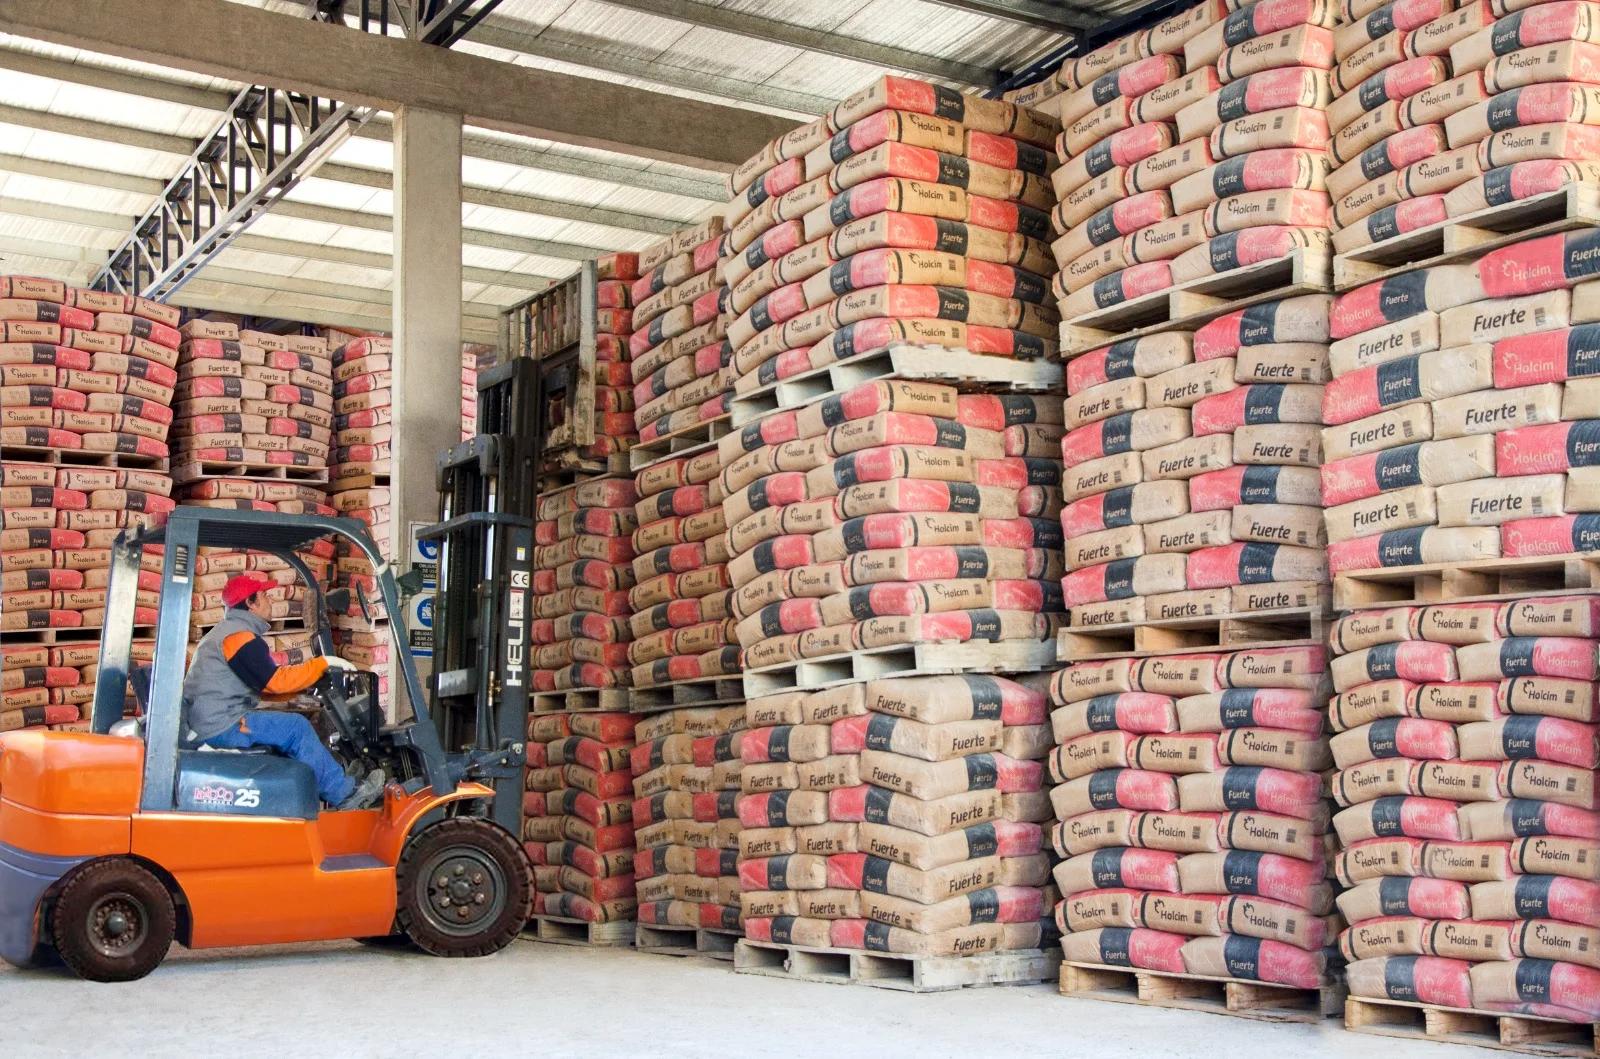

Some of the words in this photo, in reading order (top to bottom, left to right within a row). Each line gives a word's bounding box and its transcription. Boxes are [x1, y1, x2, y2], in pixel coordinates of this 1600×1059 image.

[1165, 18, 1190, 37] Holcim
[1429, 21, 1454, 37] Holcim
[1495, 30, 1516, 44] Fuerte
[1248, 40, 1274, 56] Holcim
[1352, 51, 1374, 68] Holcim
[1515, 56, 1541, 69] Holcim
[1158, 88, 1180, 104] Holcim
[1364, 87, 1381, 101] Fuerte
[1426, 91, 1451, 106] Holcim
[940, 97, 960, 110] Fuerte
[1221, 95, 1242, 111] Fuerte
[1493, 108, 1511, 120] Fuerte
[917, 122, 942, 133] Holcim
[1240, 121, 1266, 136] Holcim
[1507, 136, 1534, 149] Holcim
[1089, 153, 1108, 167] Fuerte
[1152, 158, 1177, 173] Holcim
[903, 166, 931, 179] Holcim
[1424, 165, 1450, 179] Holcim
[1218, 173, 1237, 186] Fuerte
[919, 189, 943, 200] Holcim
[1233, 202, 1260, 216] Holcim
[942, 233, 963, 243] Fuerte
[1151, 230, 1176, 245] Holcim
[1513, 264, 1551, 281] Holcim
[1100, 289, 1118, 301] Fuerte
[1385, 294, 1409, 305] Fuerte
[944, 301, 965, 310] Fuerte
[1474, 308, 1526, 332] Fuerte
[205, 328, 226, 336] Fuerte
[922, 329, 945, 337] Holcim
[1245, 326, 1267, 338] Fuerte
[258, 339, 276, 348] Fuerte
[1358, 333, 1403, 359] Fuerte
[1109, 359, 1128, 369] Fuerte
[1254, 363, 1294, 377] Fuerte
[1514, 359, 1554, 375] Holcim
[1384, 377, 1411, 391] Fuerte
[682, 390, 701, 402] Fuerte
[911, 393, 936, 402] Holcim
[1164, 382, 1198, 401] Fuerte
[207, 404, 229, 412] Fuerte
[1010, 407, 1031, 415] Fuerte
[1079, 399, 1110, 418] Fuerte
[1250, 406, 1273, 416] Fuerte
[1465, 403, 1517, 425] Fuerte
[942, 431, 962, 441] Fuerte
[1350, 422, 1395, 447] Fuerte
[1253, 443, 1293, 457] Fuerte
[924, 458, 950, 466] Holcim
[1513, 452, 1555, 464] Holcim
[1159, 456, 1194, 474] Fuerte
[1382, 463, 1411, 476] Fuerte
[1077, 472, 1108, 490] Fuerte
[856, 491, 875, 501] Holcim
[954, 496, 976, 505] Fuerte
[1470, 494, 1522, 514] Fuerte
[1353, 503, 1398, 528] Fuerte
[934, 524, 959, 532] Holcim
[1250, 522, 1291, 539] Fuerte
[1160, 531, 1195, 548] Fuerte
[1385, 545, 1412, 557] Fuerte
[1518, 540, 1559, 552] Holcim
[1078, 545, 1110, 561] Fuerte
[963, 561, 983, 569] Fuerte
[1244, 566, 1267, 575] Fuerte
[802, 576, 820, 585] Holcim
[944, 588, 969, 597] Holcim
[1248, 594, 1289, 609] Fuerte
[1161, 603, 1197, 618] Fuerte
[1081, 610, 1114, 625] Fuerte
[1527, 613, 1556, 623] Holcim
[1355, 624, 1380, 636] Holcim
[1437, 619, 1464, 629] Holcim
[506, 620, 523, 686] HELI
[1506, 657, 1527, 667] Fuerte
[1158, 669, 1183, 680] Holcim
[1247, 664, 1276, 675] Holcim
[1076, 676, 1100, 687] Holcim
[1529, 691, 1557, 701] Holcim
[877, 696, 906, 712] Fuerte
[1436, 698, 1462, 707] Holcim
[754, 711, 776, 722] Fuerte
[813, 705, 838, 719] Fuerte
[1225, 709, 1247, 719] Fuerte
[684, 721, 706, 732] Fuerte
[952, 735, 985, 750] Fuerte
[1248, 741, 1277, 753] Holcim
[1373, 740, 1393, 750] Fuerte
[1156, 749, 1182, 759] Holcim
[680, 776, 698, 787] Fuerte
[809, 772, 834, 785] Fuerte
[872, 767, 902, 786] Fuerte
[1438, 776, 1466, 786] Holcim
[1530, 776, 1559, 788] Holcim
[234, 789, 260, 807] 25
[1093, 792, 1113, 801] Fuerte
[1228, 790, 1250, 799] Fuerte
[950, 806, 983, 825] Fuerte
[1518, 817, 1539, 827] Fuerte
[684, 831, 702, 842] Fuerte
[1079, 826, 1101, 838] Holcim
[1158, 827, 1185, 838] Holcim
[1250, 827, 1279, 839] Holcim
[807, 839, 832, 850] Fuerte
[870, 840, 899, 857] Fuerte
[973, 841, 992, 850] Fuerte
[1541, 850, 1570, 861] Holcim
[1448, 857, 1474, 867] Holcim
[949, 874, 982, 892] Fuerte
[1230, 875, 1252, 885] Fuerte
[809, 902, 835, 914] Fuerte
[1385, 900, 1406, 909] Fuerte
[1521, 898, 1542, 908] Fuerte
[871, 907, 900, 924] Fuerte
[1161, 911, 1187, 921] Holcim
[1250, 916, 1278, 929] Holcim
[953, 933, 985, 950] Fuerte
[1450, 935, 1478, 946] Holcim
[1542, 936, 1571, 948] Holcim
[1105, 950, 1126, 960] Fuerte
[1230, 959, 1254, 970] Fuerte
[1391, 985, 1411, 994] Fuerte
[1522, 984, 1544, 993] Fuerte
